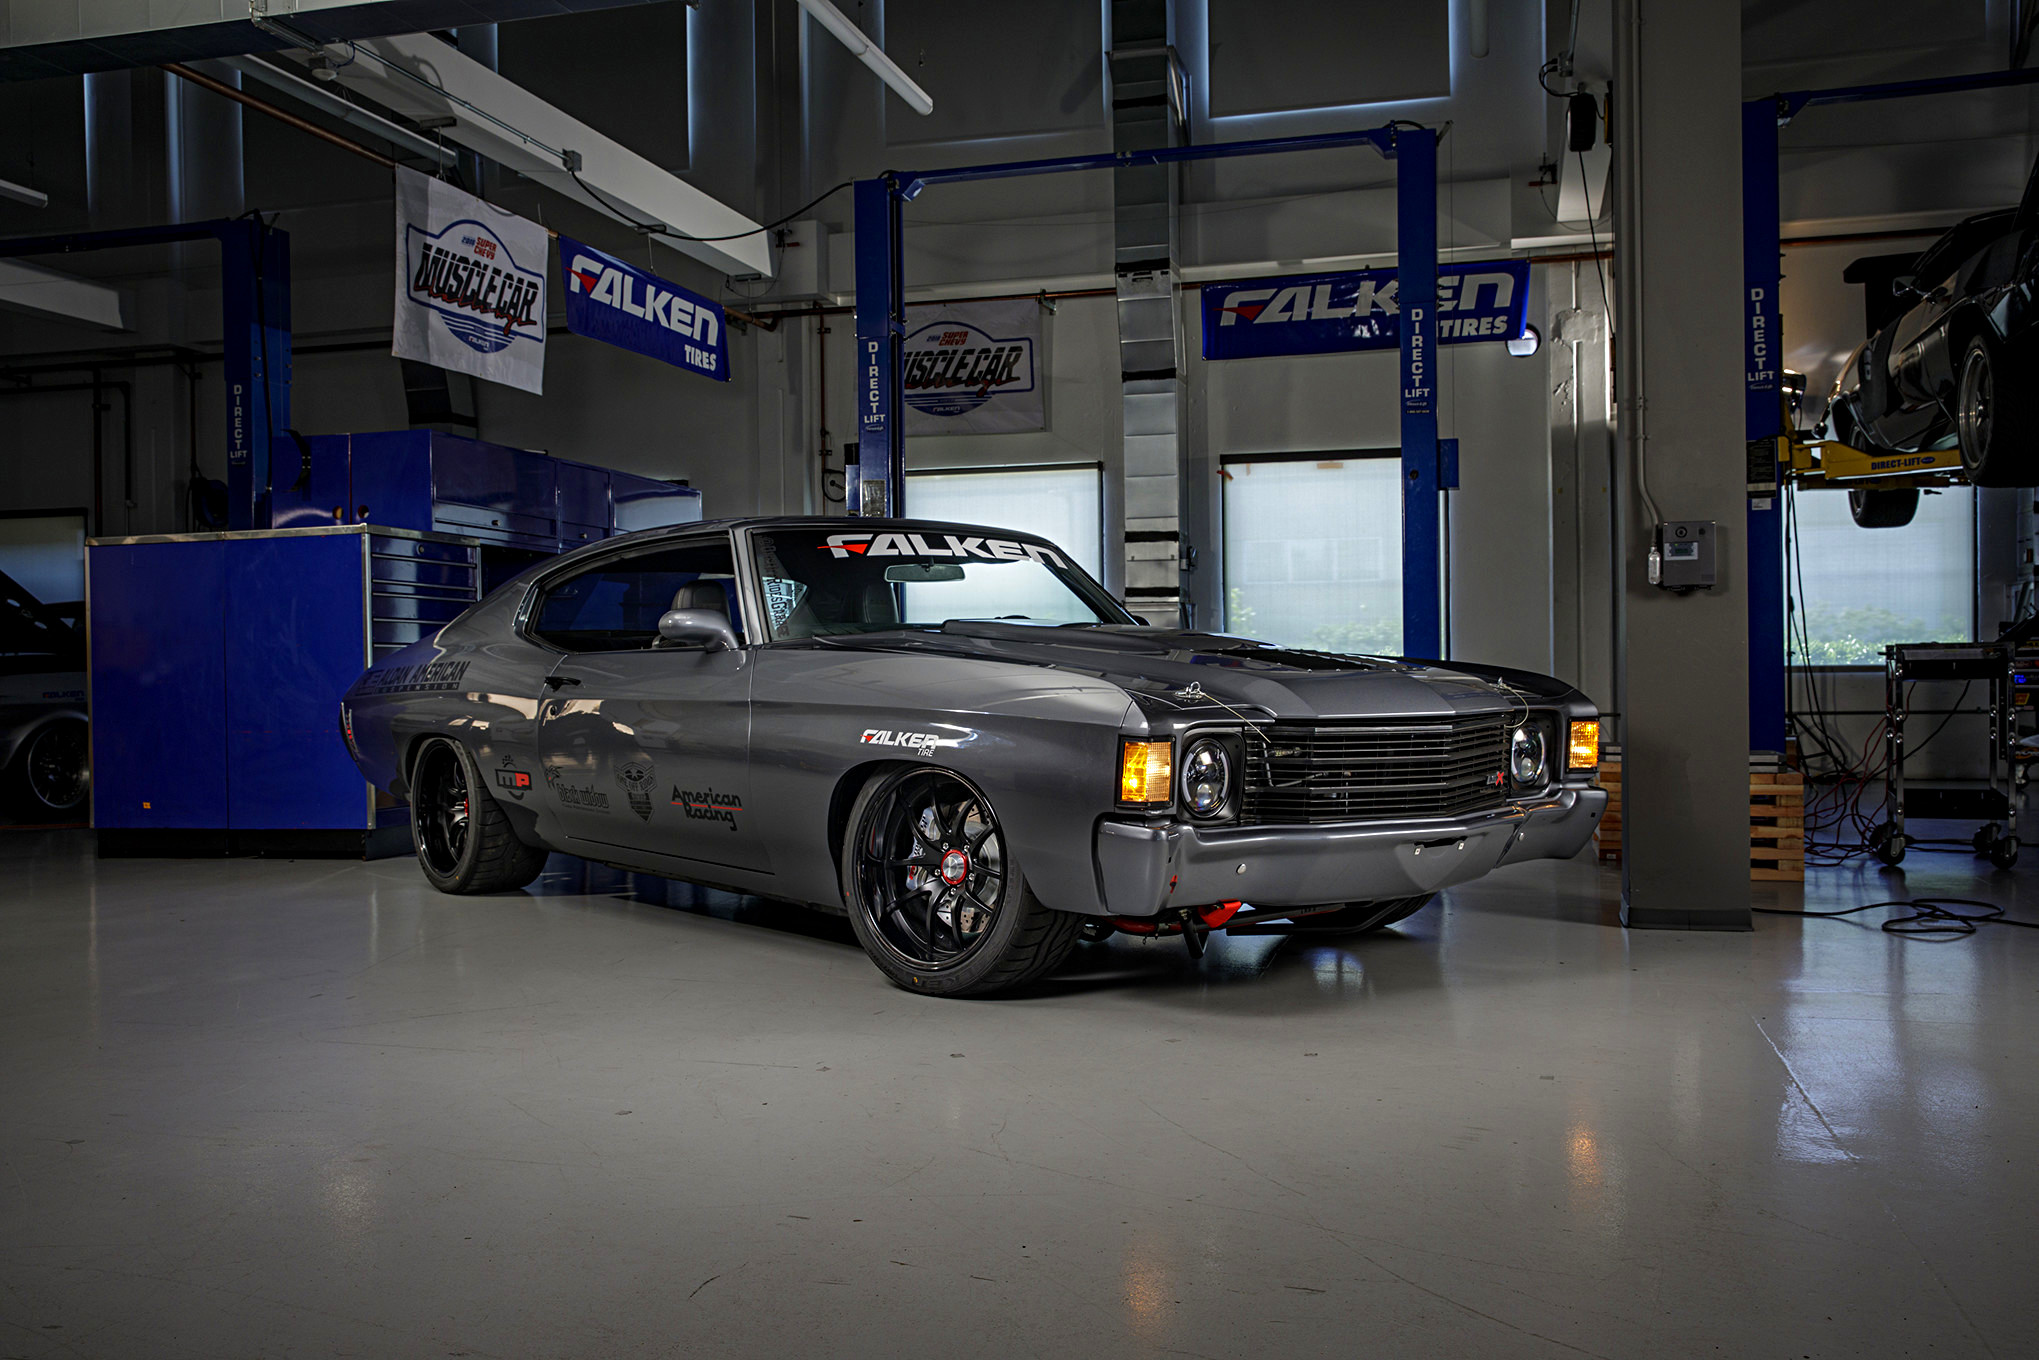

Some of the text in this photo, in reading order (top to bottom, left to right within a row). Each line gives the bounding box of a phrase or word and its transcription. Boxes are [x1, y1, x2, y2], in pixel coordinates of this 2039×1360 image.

[473, 245, 495, 260] CHEVY
[476, 237, 497, 252] SUPER
[567, 254, 719, 346] FALKEN
[942, 331, 969, 339] SUPER
[1440, 316, 1509, 338] TIRES
[1751, 288, 1767, 370] DIRECT
[684, 344, 717, 371] TIRES
[1411, 308, 1424, 387] DIRECT
[868, 341, 880, 414] DIRECT
[904, 346, 1023, 389] USCLECAR
[1747, 370, 1775, 382] LIFT
[1404, 388, 1430, 398] LIFT
[863, 414, 886, 424] LIFT
[229, 450, 248, 459] LIFT
[1871, 457, 1921, 470] DIRECT-LIFT
[817, 533, 1068, 570] FALKEN
[408, 660, 471, 683] AMERICAN
[374, 682, 459, 693] USPENSION
[859, 729, 940, 750] FALKEN
[671, 784, 742, 807] American
[684, 803, 738, 831] Racing
